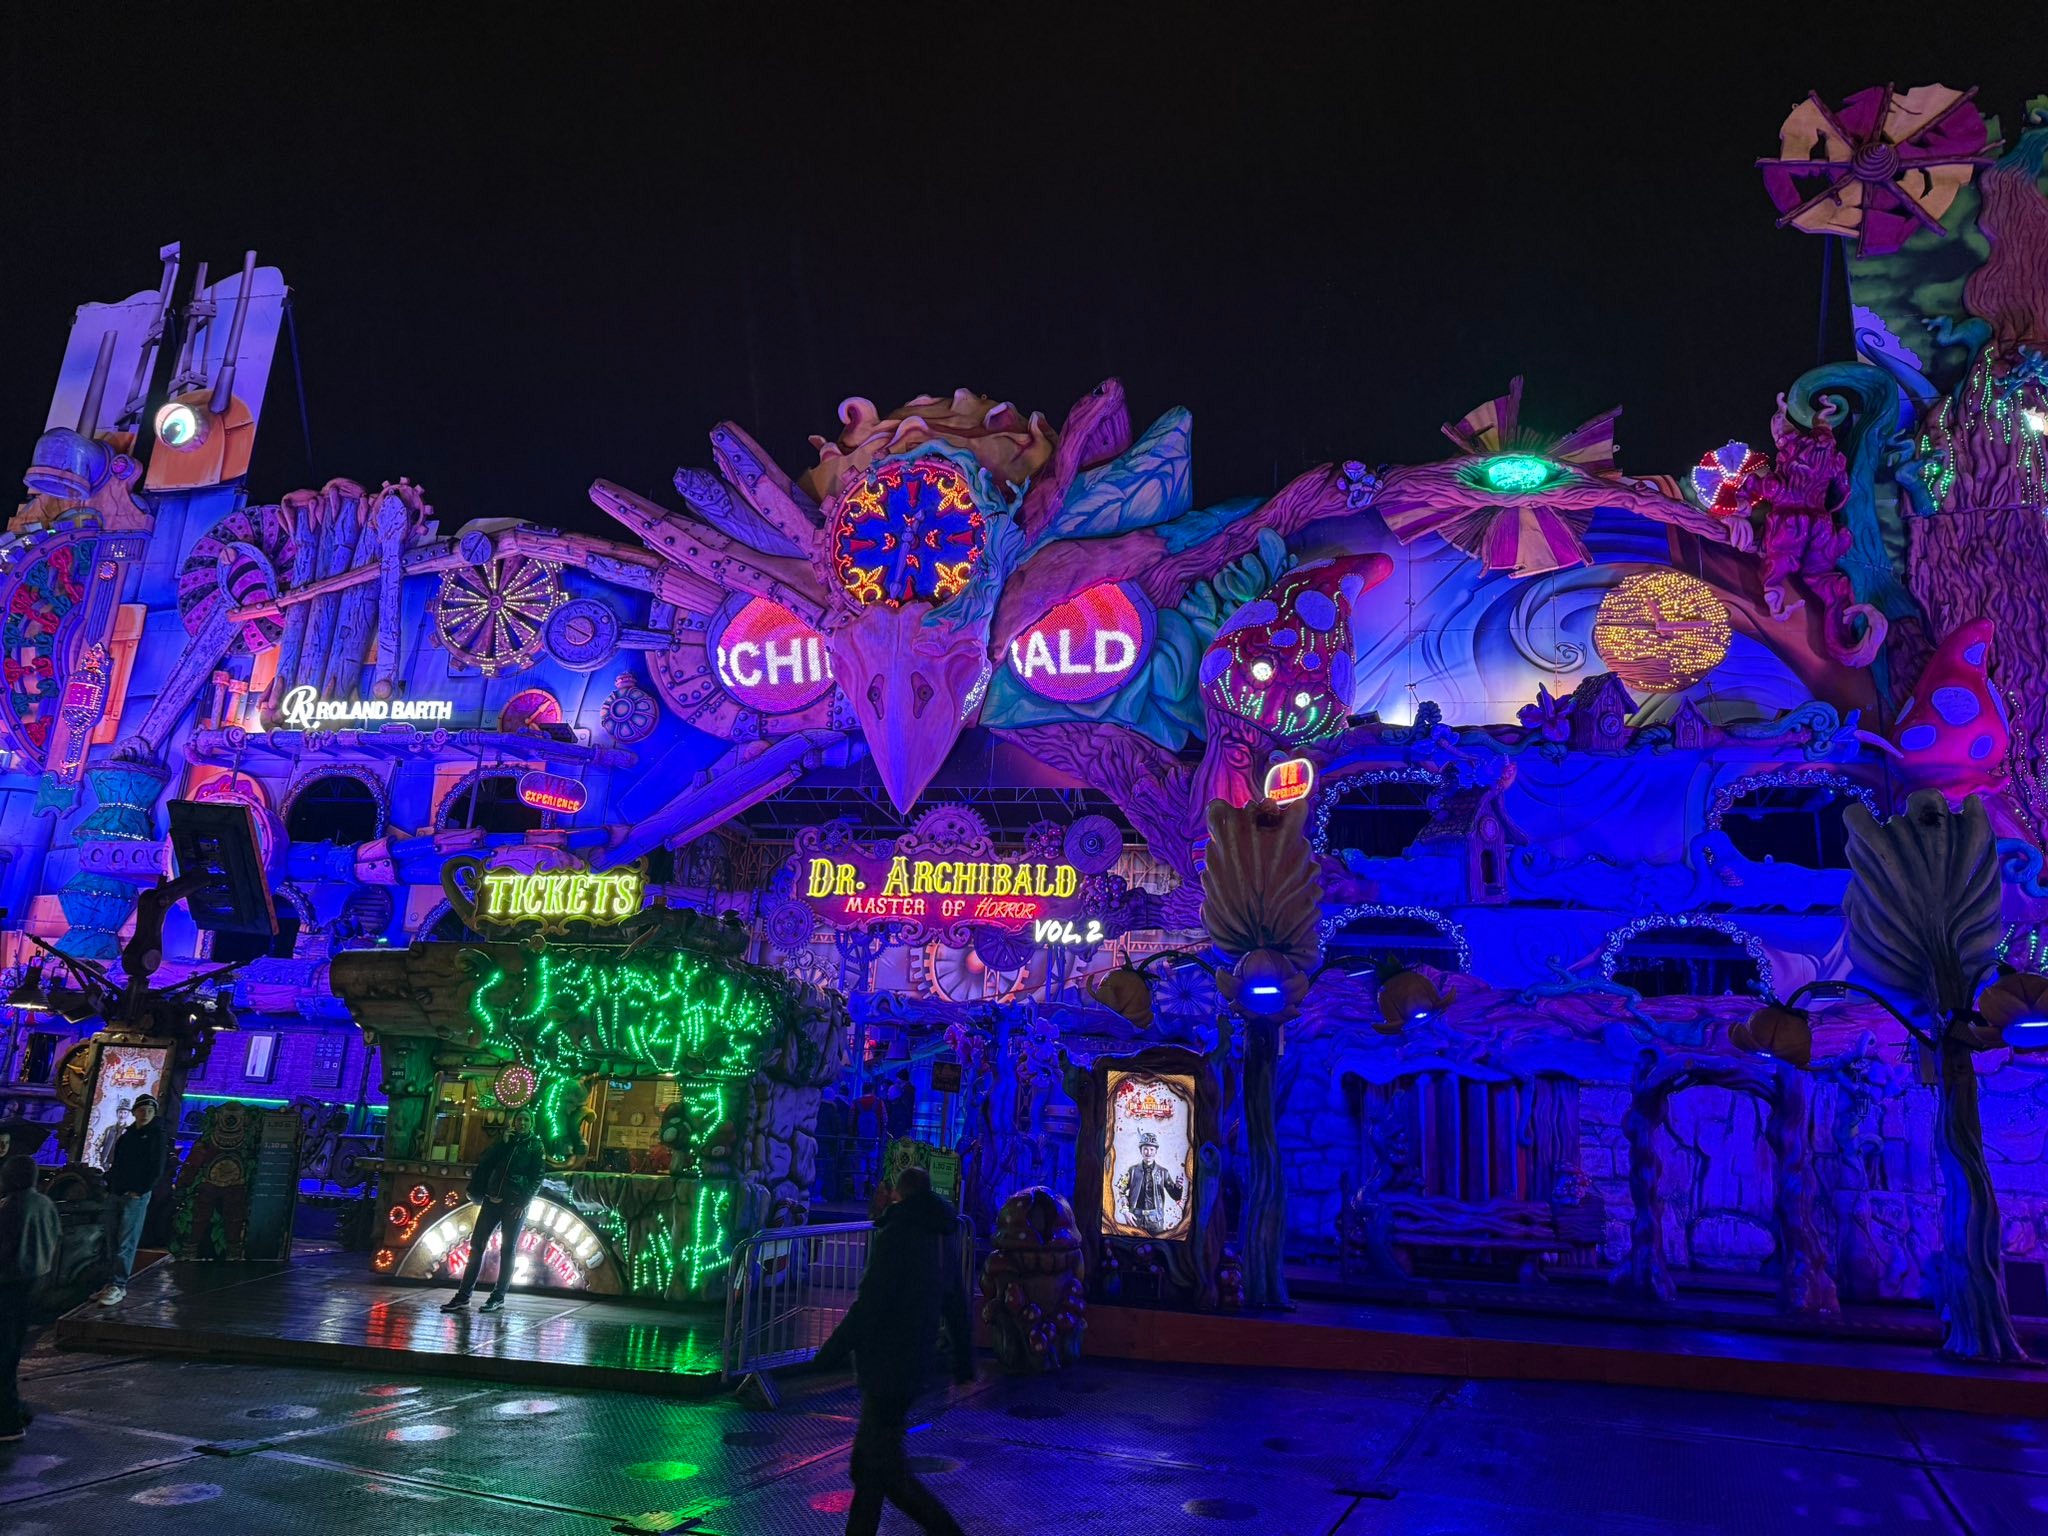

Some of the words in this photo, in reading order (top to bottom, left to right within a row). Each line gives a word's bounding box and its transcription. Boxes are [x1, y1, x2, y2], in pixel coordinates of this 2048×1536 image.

[1011, 629, 1138, 679] ALD
[316, 701, 388, 719] ROLAND
[391, 701, 452, 720] BARTH
[1280, 762, 1298, 786] VR
[525, 790, 580, 811] EXPERIENCE
[1269, 783, 1307, 800] EXPERIENCE
[806, 858, 866, 897] DR.
[881, 855, 1077, 897] ARCHIBALD
[485, 874, 638, 916] TICKETS
[845, 897, 925, 916] MASTER
[941, 900, 965, 916] OF
[974, 898, 1036, 919] HORROR
[1086, 920, 1104, 943] 2
[511, 1256, 530, 1283] 2
[544, 1241, 580, 1286] TIME
